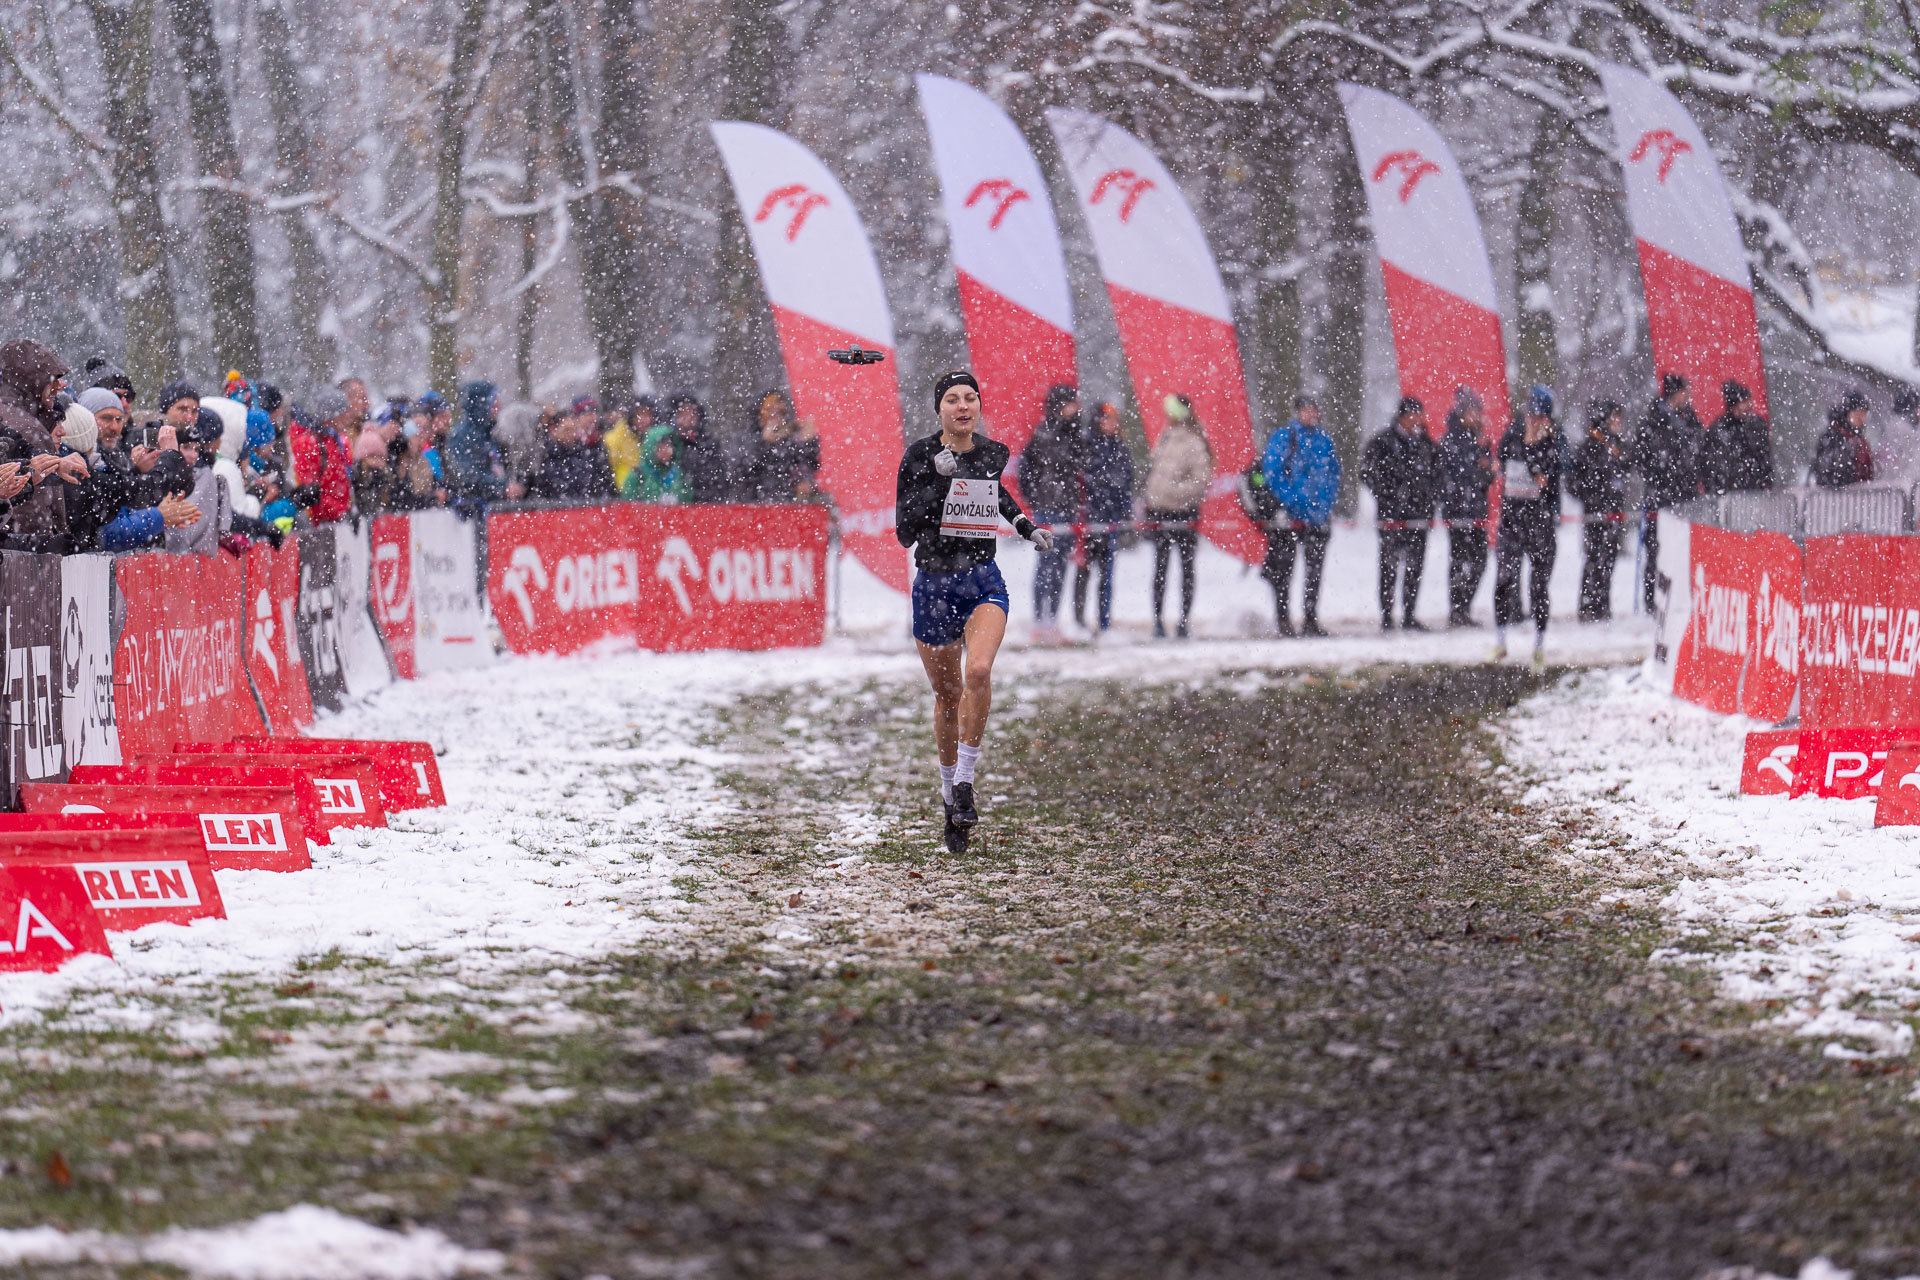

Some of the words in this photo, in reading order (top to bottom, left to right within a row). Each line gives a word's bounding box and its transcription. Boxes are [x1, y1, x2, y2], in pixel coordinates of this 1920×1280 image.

[946, 501, 998, 517] DOMŻALSKA
[708, 548, 815, 602] ORLEN
[315, 785, 356, 808] EN
[203, 819, 276, 845] LEN
[83, 869, 189, 900] RLEN
